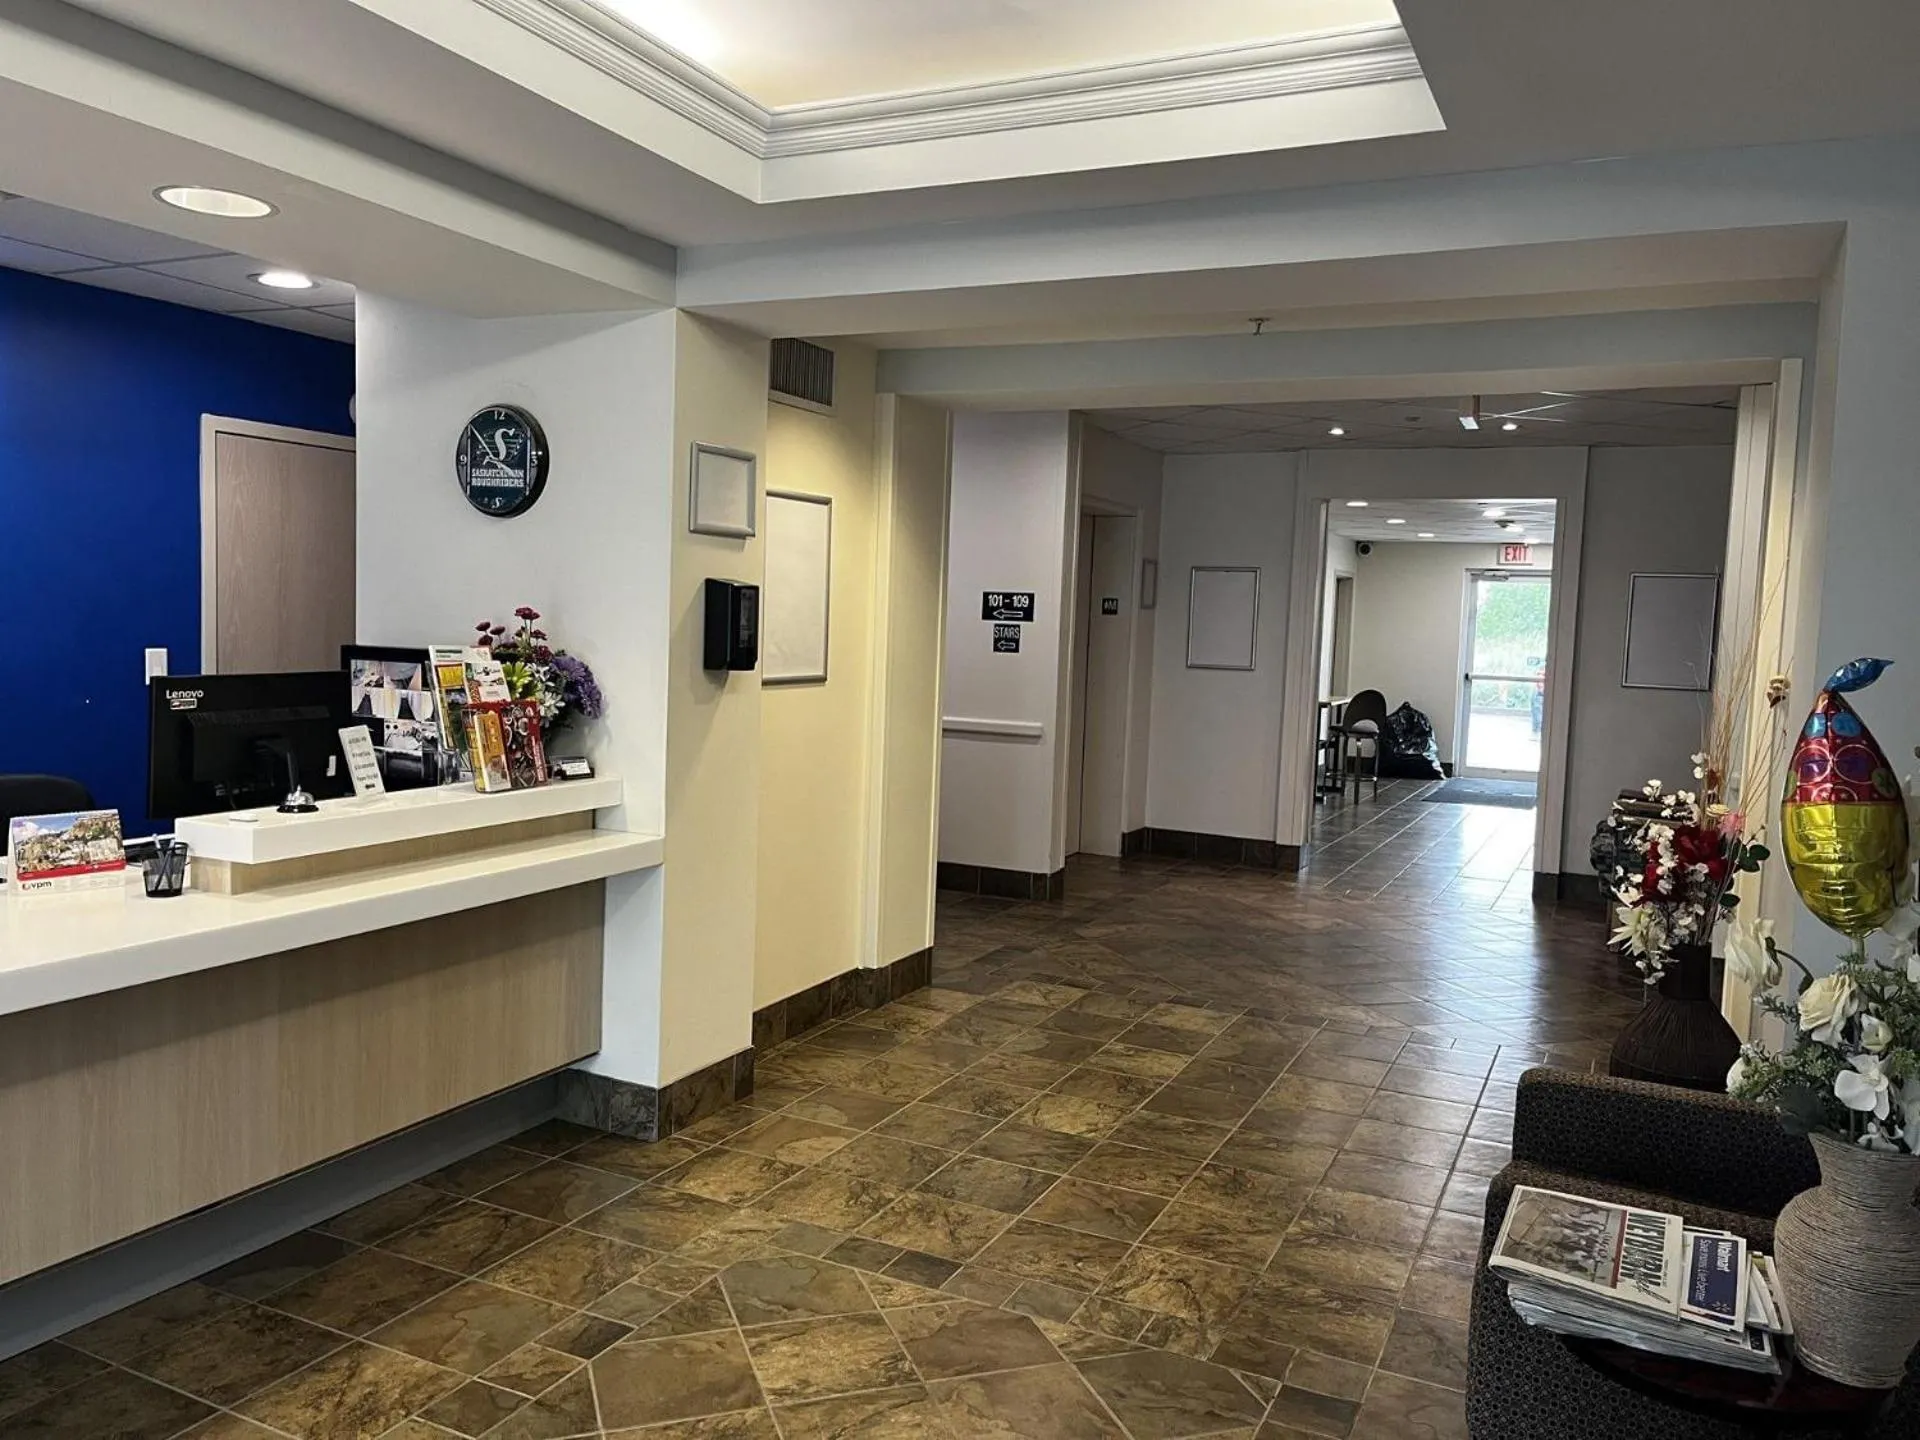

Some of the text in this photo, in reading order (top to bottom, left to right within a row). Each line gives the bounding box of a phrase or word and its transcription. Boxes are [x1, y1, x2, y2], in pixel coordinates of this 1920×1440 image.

[1505, 545, 1529, 562] EXIT
[988, 594, 1003, 607] 101
[1013, 595, 1029, 608] 109
[994, 626, 1020, 639] STAIRS
[165, 689, 204, 699] Lenovo
[1716, 1240, 1731, 1272] Walmart
